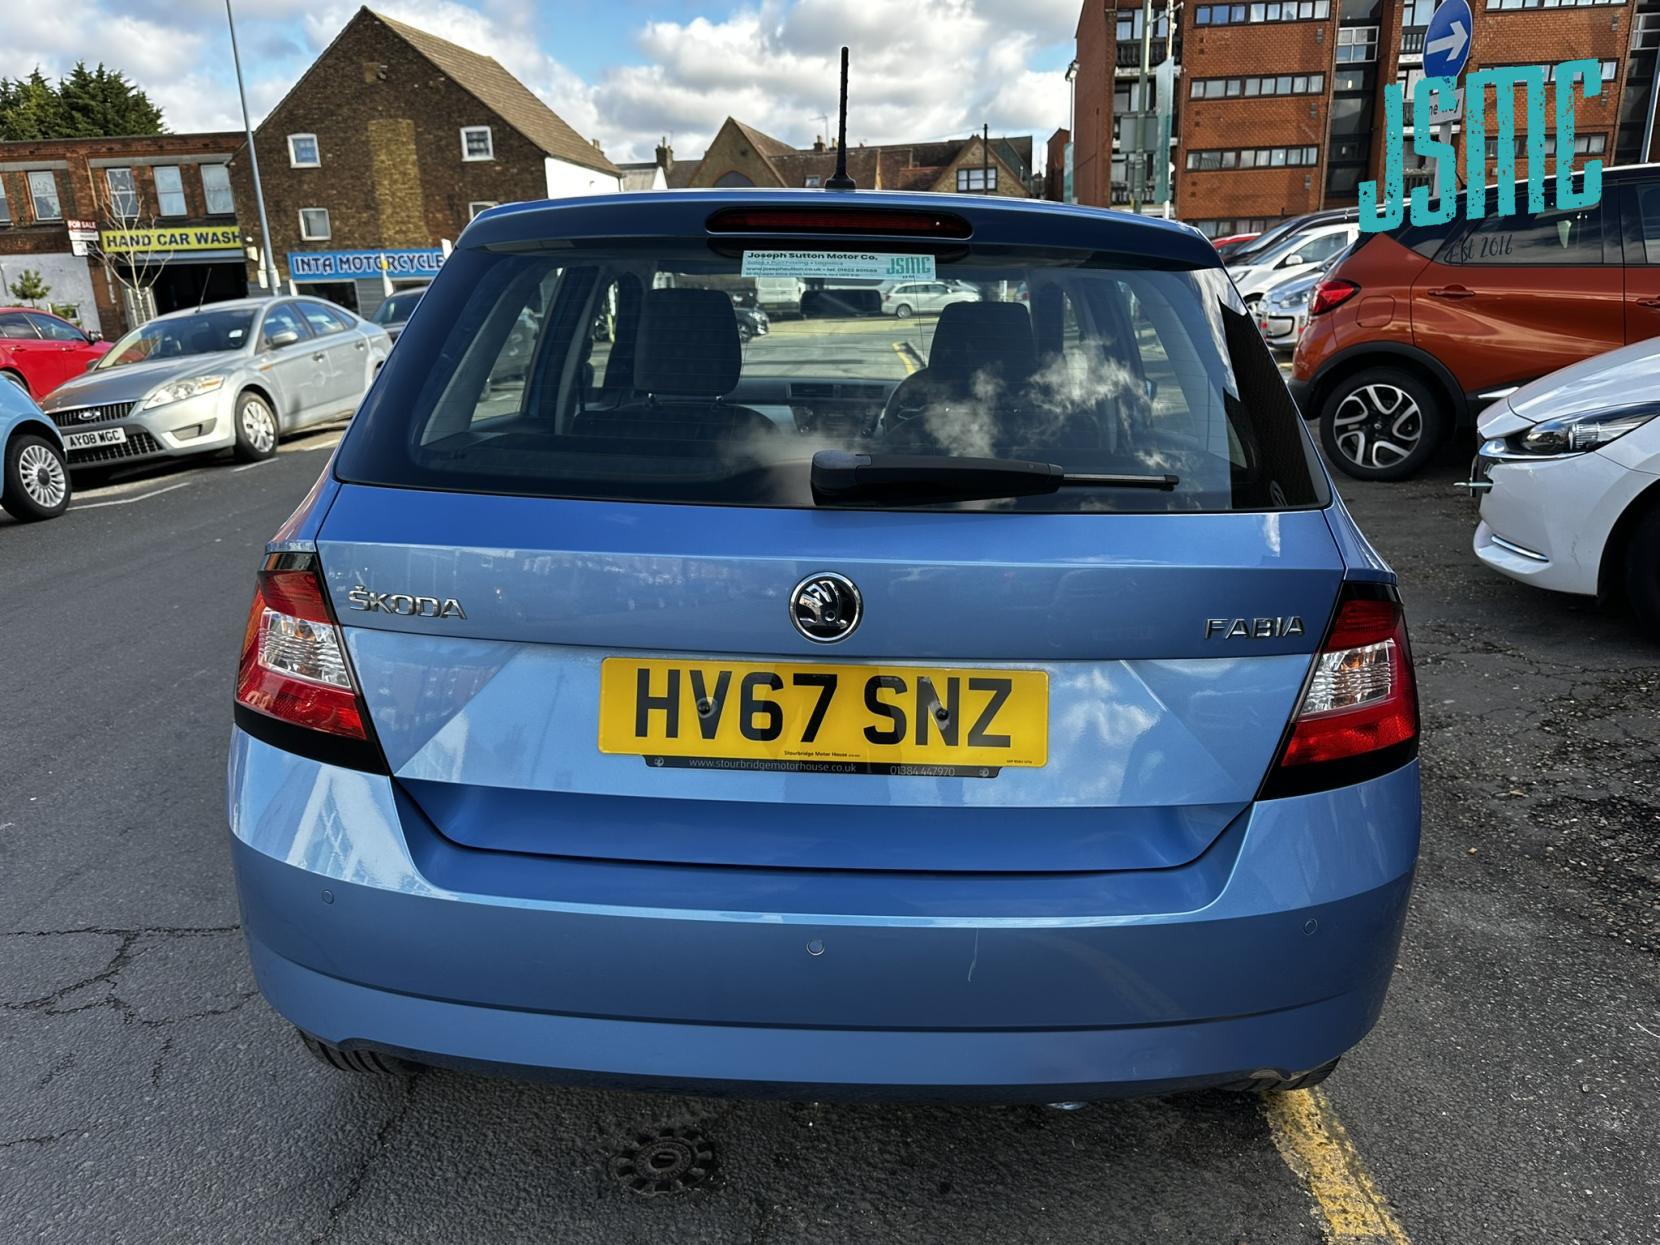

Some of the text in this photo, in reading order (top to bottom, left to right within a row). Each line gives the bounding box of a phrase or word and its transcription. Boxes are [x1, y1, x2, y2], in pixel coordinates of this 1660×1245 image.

[68, 220, 96, 229] FOR SALE
[106, 231, 240, 247] HAND CAR WASH
[748, 252, 786, 260] Joseph
[294, 256, 333, 274] INTA
[886, 256, 931, 274] JSMC
[69, 431, 120, 447] AY08 WGC
[348, 585, 468, 620] ŠKODA
[1205, 616, 1304, 639] FABIA
[635, 668, 1013, 748] HV67 SNZ
[689, 759, 856, 772] www.stourbridgemotorhouse.co.uk
[890, 766, 955, 776] 01384 447970
